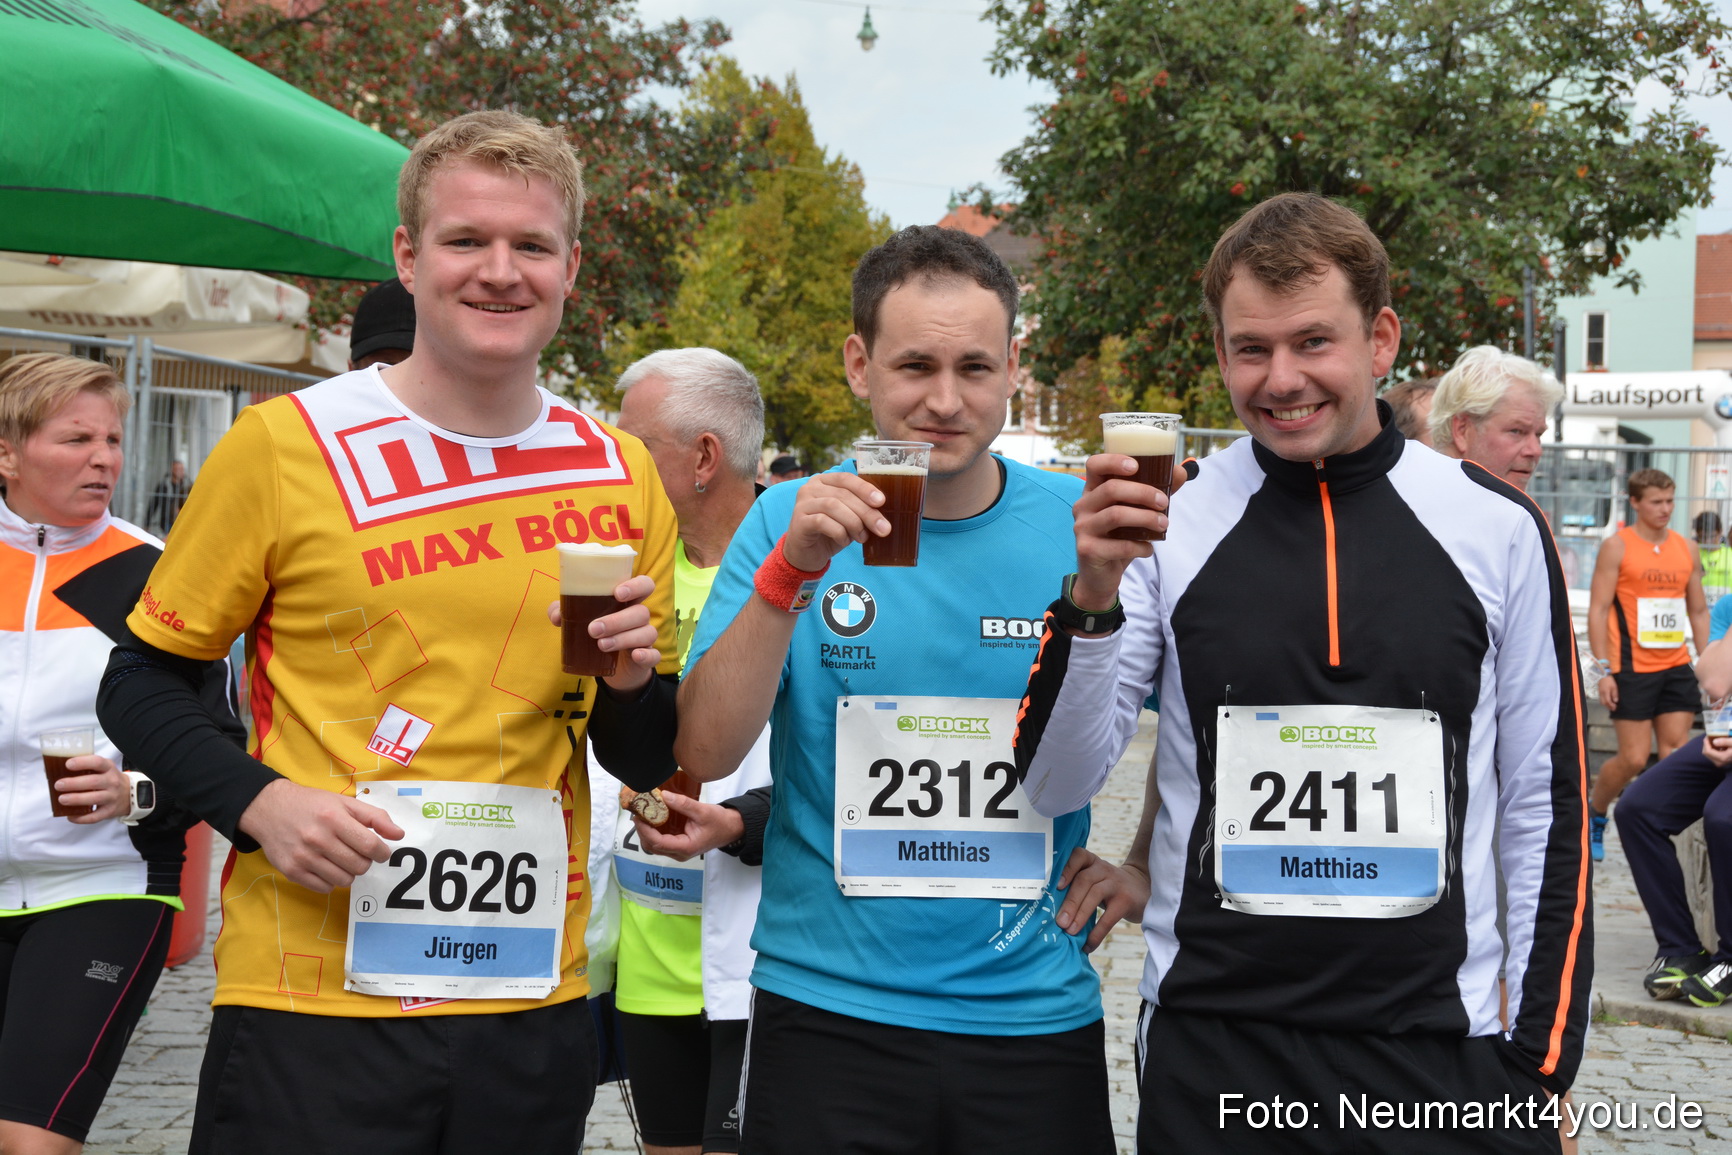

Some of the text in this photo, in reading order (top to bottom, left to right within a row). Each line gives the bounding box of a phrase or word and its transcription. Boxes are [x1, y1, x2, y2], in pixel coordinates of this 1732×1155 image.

[1573, 384, 1704, 409] Laufsport
[361, 499, 644, 588] MAX BÖGL
[826, 583, 872, 604] BMW
[981, 617, 1045, 640] BO
[1652, 614, 1677, 629] 105
[820, 643, 877, 660] PARTL
[980, 641, 1013, 649] inspired
[1016, 642, 1026, 650] by
[821, 658, 877, 671] Neumarkt
[918, 716, 990, 734] BOCK
[1301, 726, 1377, 744] BOCK
[868, 758, 1018, 819] 2312
[1249, 771, 1399, 833] 2411
[445, 802, 515, 822] BOCK
[847, 809, 855, 821] C
[1228, 824, 1235, 835] C
[898, 840, 990, 862] Matthias
[1280, 856, 1378, 879] Matthias
[385, 846, 538, 915] 2626
[645, 871, 684, 890] Alfons
[362, 900, 370, 912] D
[424, 936, 497, 965] Jürgen
[994, 940, 1009, 952] 17.
[91, 960, 121, 974] TAO
